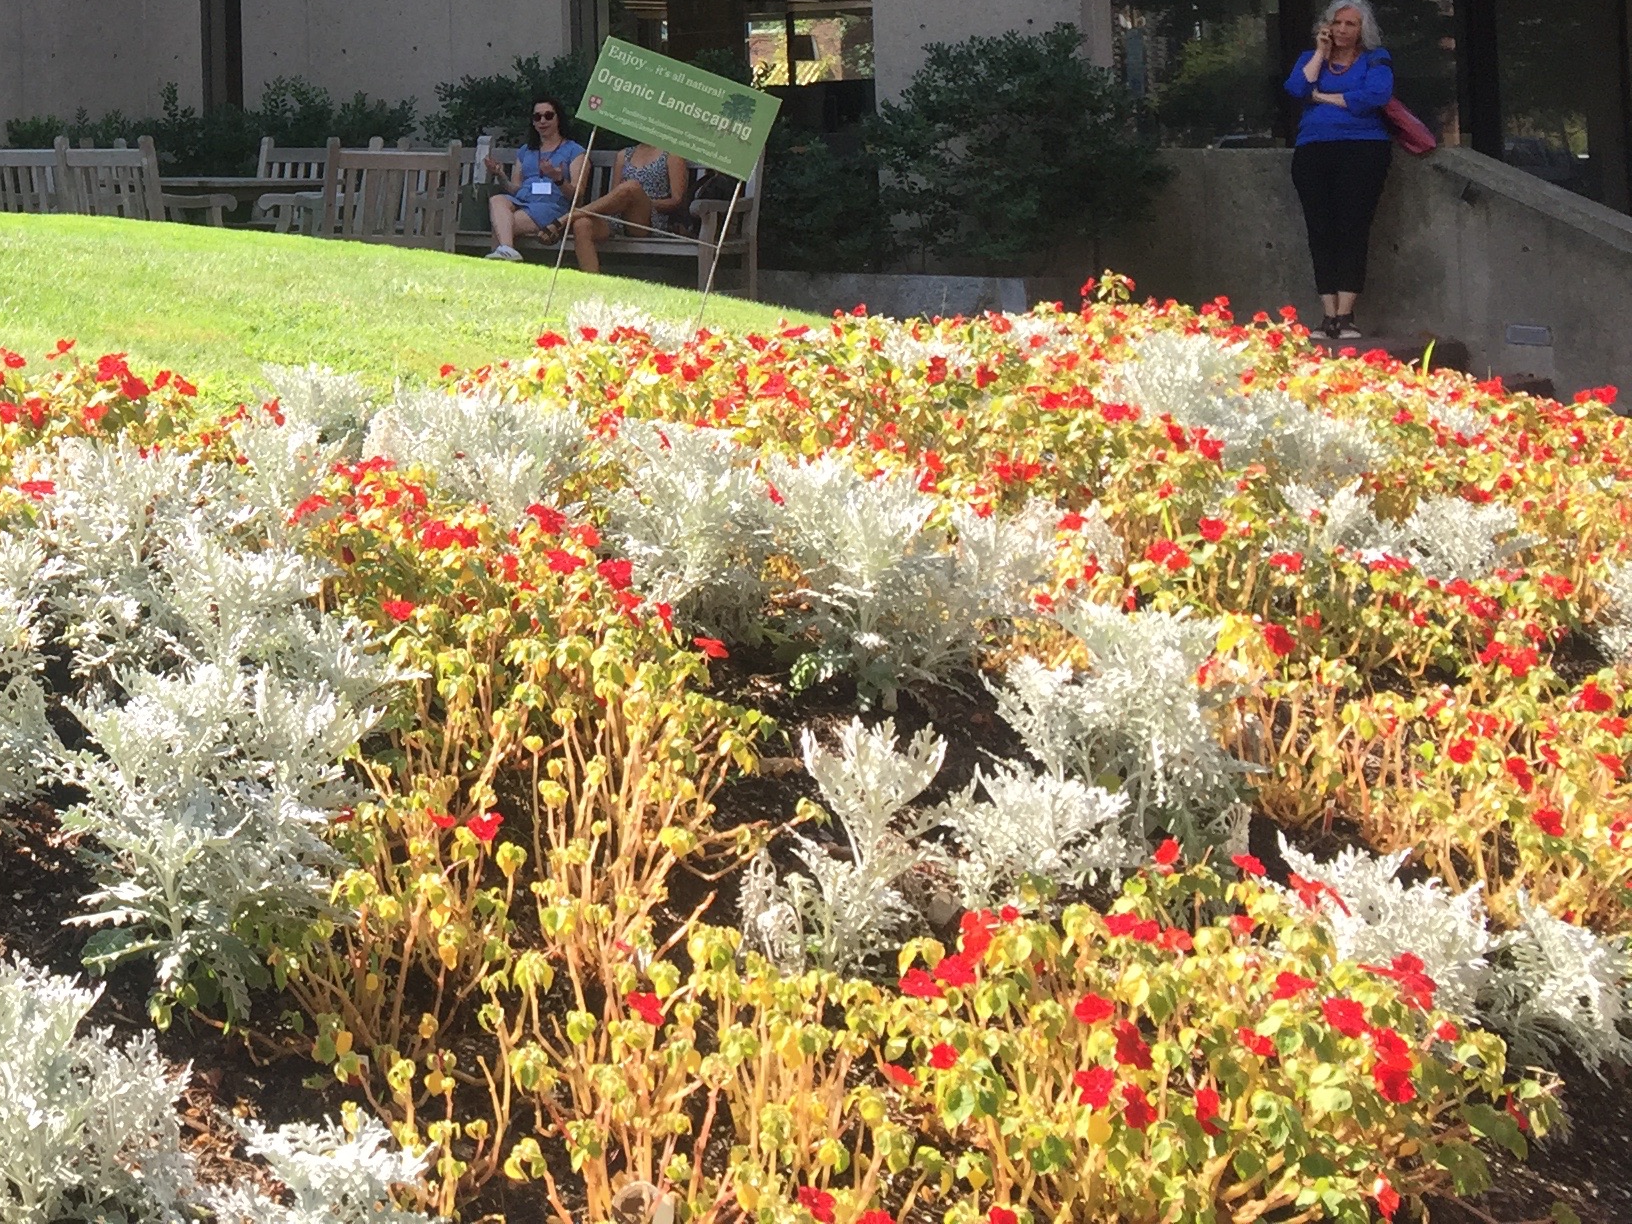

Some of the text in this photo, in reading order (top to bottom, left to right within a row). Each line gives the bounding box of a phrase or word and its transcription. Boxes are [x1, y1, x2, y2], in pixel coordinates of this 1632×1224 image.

[655, 65, 670, 80] it's
[672, 73, 686, 86] all
[597, 68, 655, 101] Organic
[658, 90, 753, 141] Landscapng
